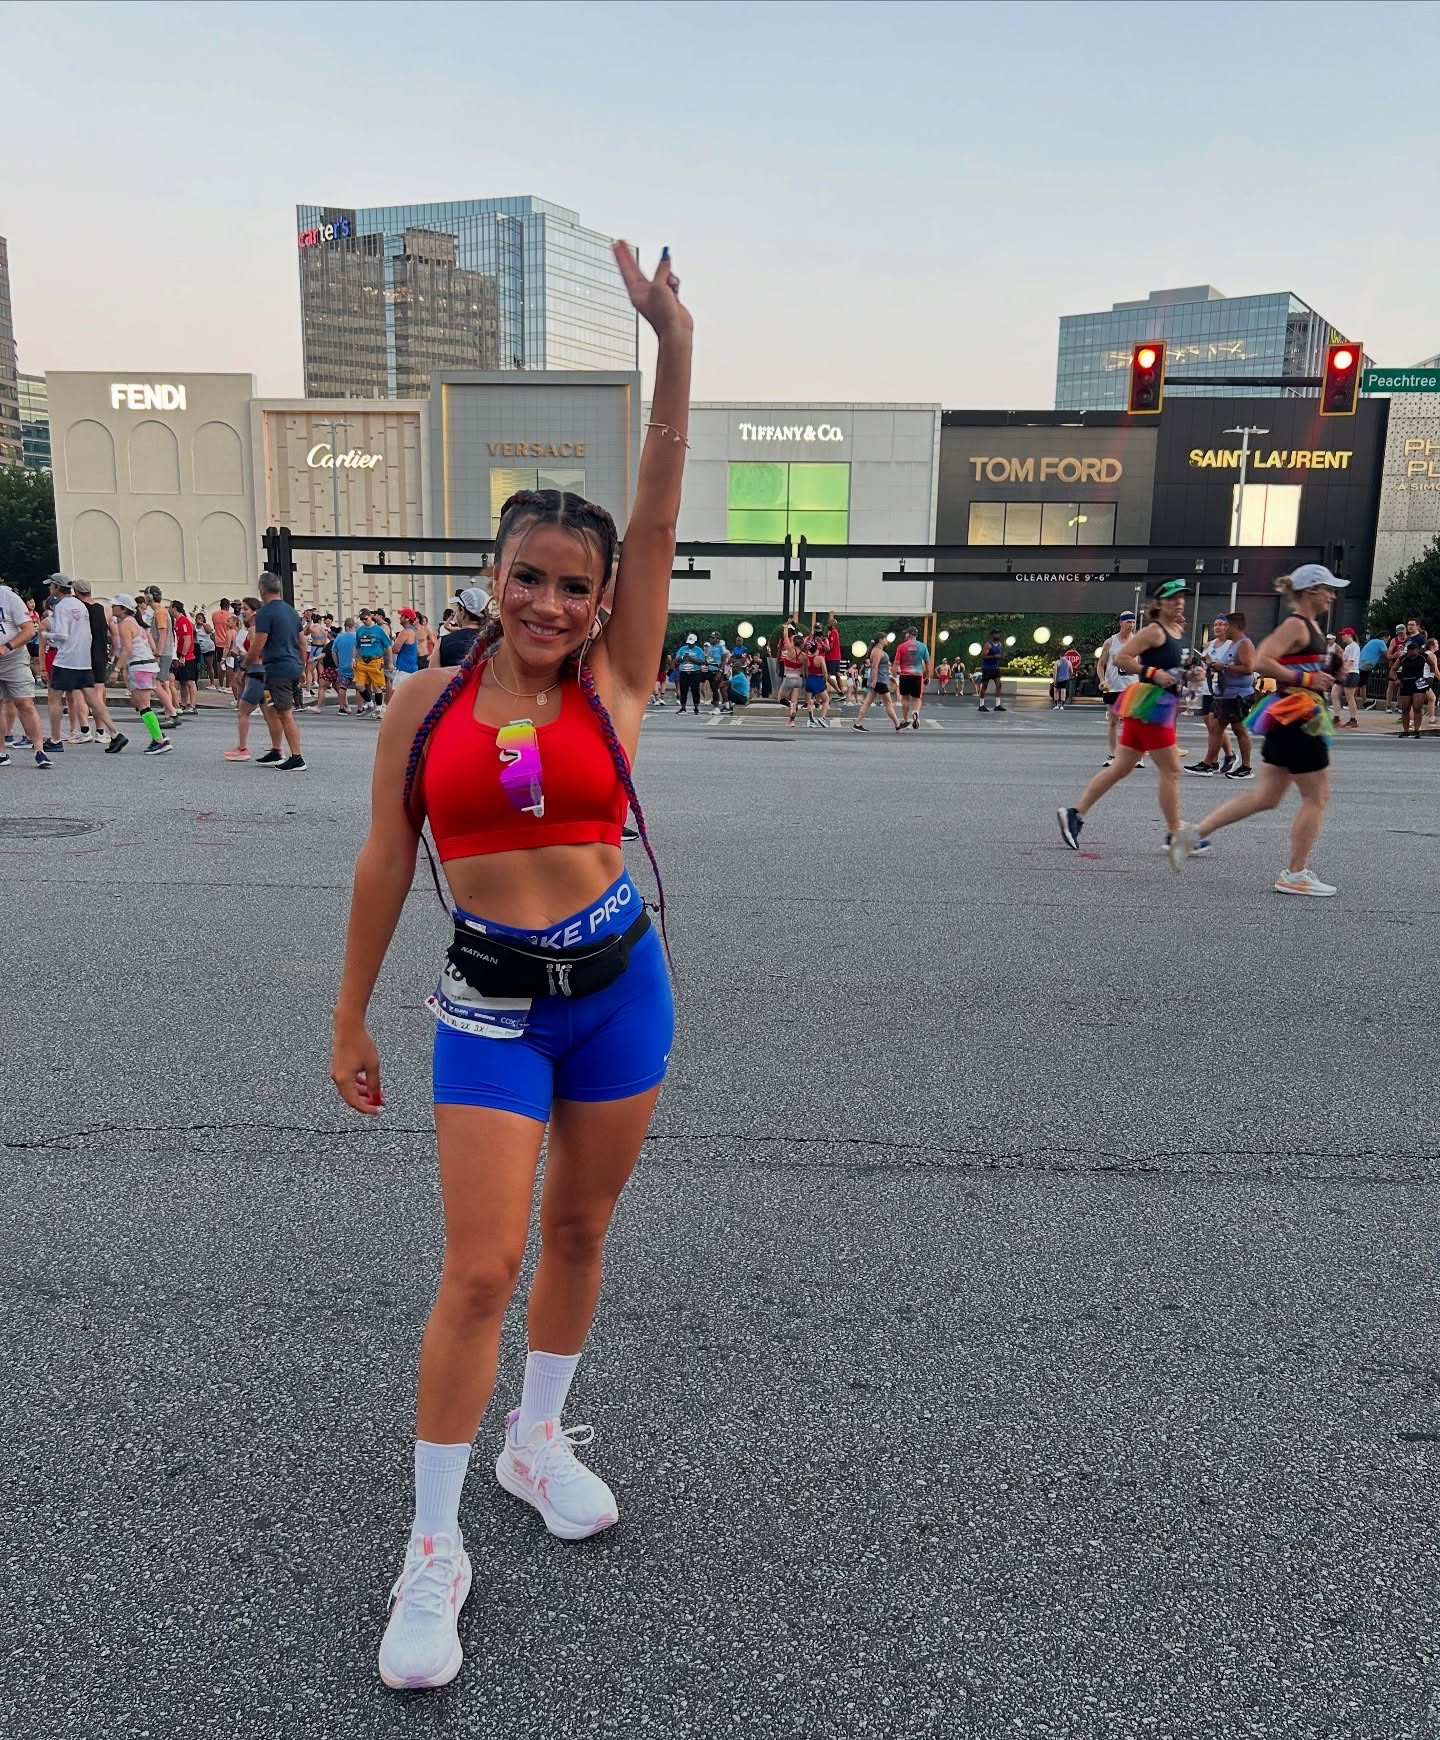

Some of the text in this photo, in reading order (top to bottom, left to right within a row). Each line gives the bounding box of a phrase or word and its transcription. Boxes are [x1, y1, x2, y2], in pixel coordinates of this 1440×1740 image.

[298, 214, 349, 248] carter's
[1368, 374, 1437, 387] Peachtree
[111, 383, 187, 410] FENDI
[306, 443, 383, 468] Cartier
[487, 441, 585, 457] VERSACE
[1189, 448, 1353, 469] SAINT LAURENT
[969, 457, 1122, 483] TOM FORD
[1015, 573, 1080, 582] CLEARANCE
[1065, 655, 1080, 664] TOP
[589, 883, 632, 934] PRO
[460, 946, 499, 965] NATHAN
